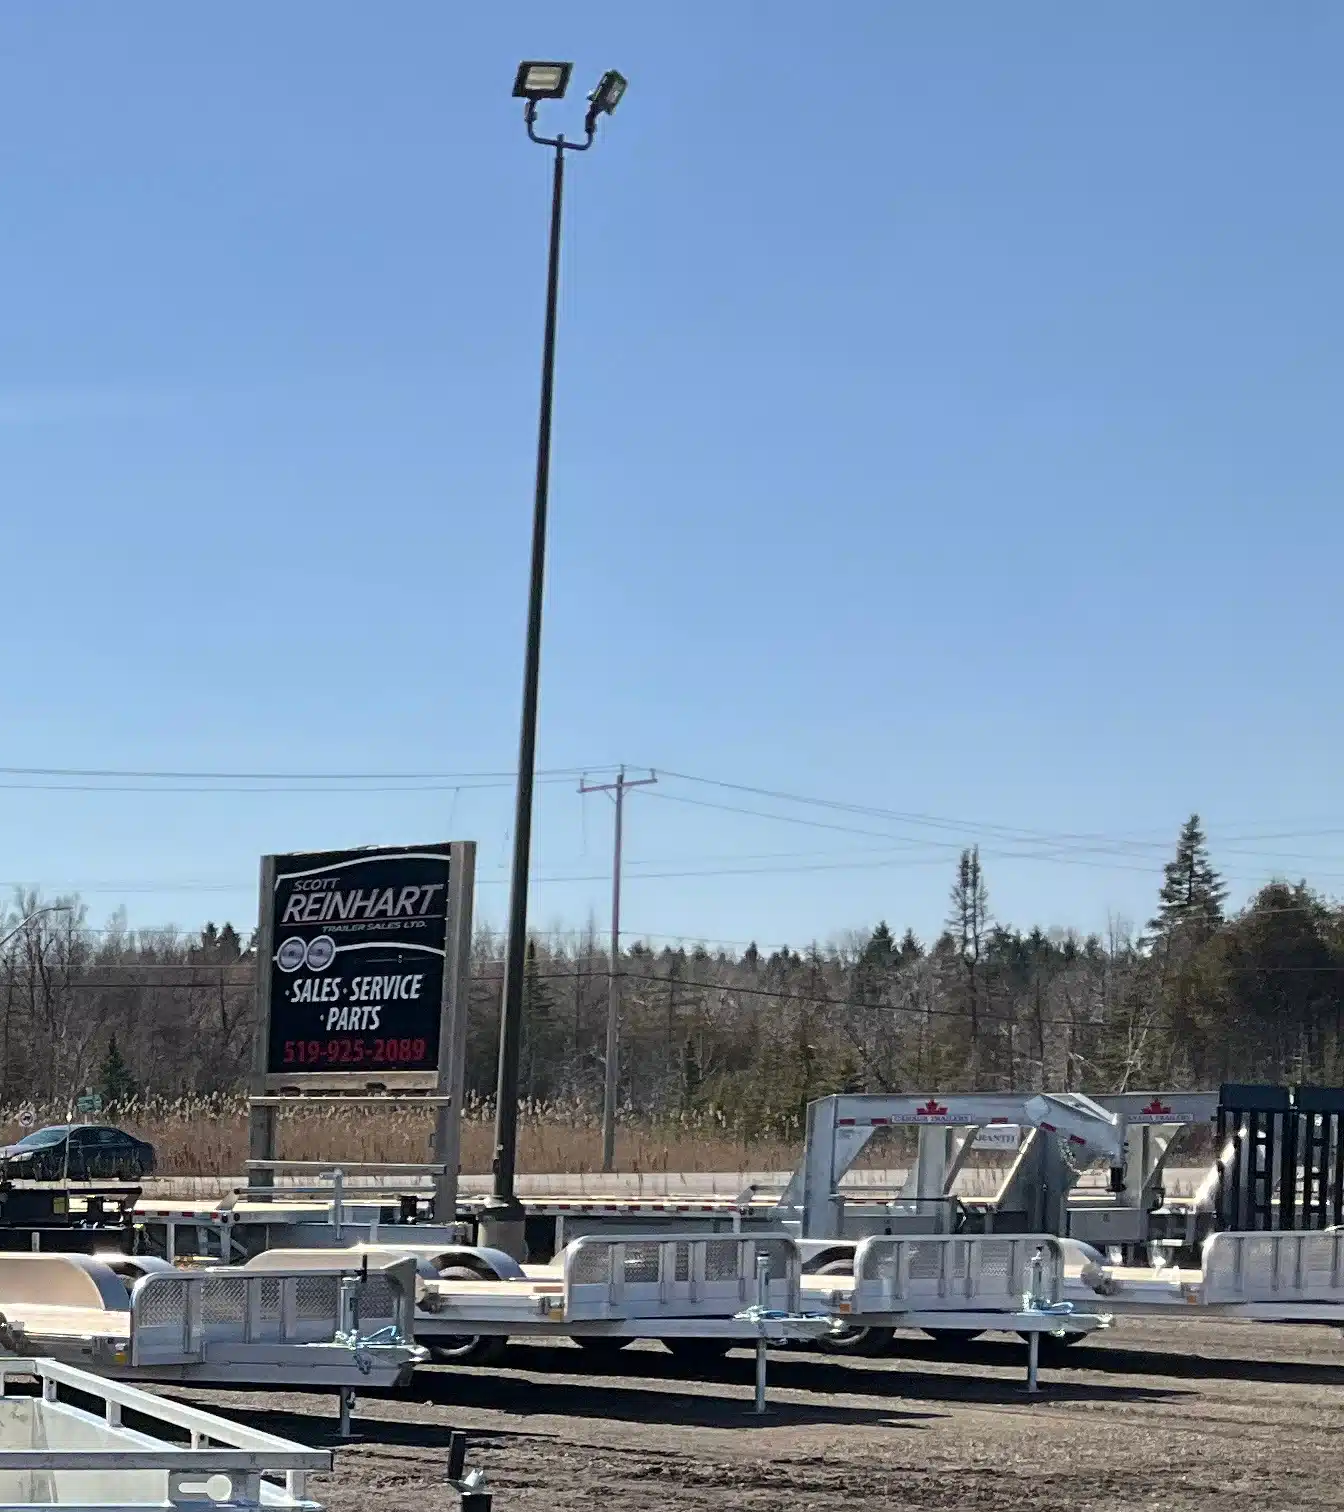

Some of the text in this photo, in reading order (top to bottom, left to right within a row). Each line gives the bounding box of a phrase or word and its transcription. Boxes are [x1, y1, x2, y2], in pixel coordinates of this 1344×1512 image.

[292, 877, 340, 892] SCOTT
[281, 884, 444, 923] REINHART
[322, 923, 366, 933] TRAILER
[367, 922, 401, 931] SALES
[290, 974, 423, 1003] SALES SERVICE
[326, 1005, 382, 1031] PARTS
[282, 1038, 427, 1064] 519-925-2089
